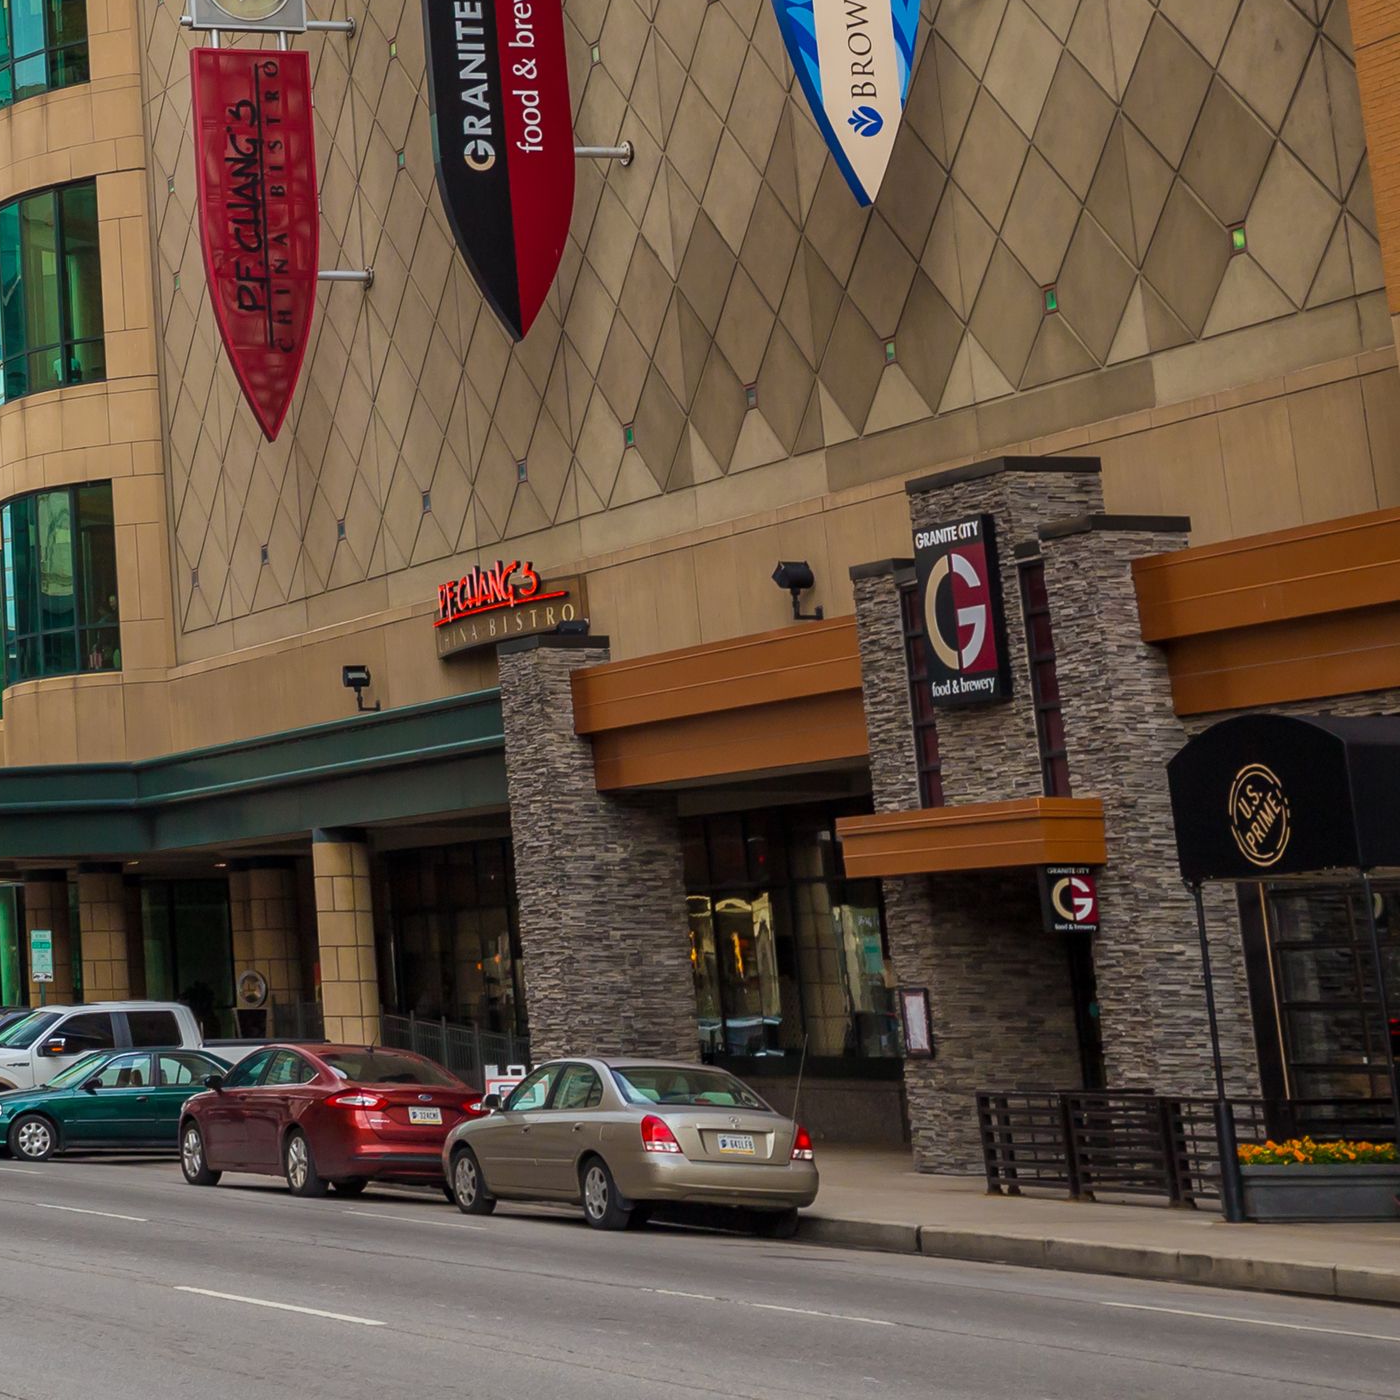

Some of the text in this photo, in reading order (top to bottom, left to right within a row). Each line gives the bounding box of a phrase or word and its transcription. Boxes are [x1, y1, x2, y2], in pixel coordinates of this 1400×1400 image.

[454, 1, 496, 171] GRANITE
[512, 58, 538, 79] &
[512, 90, 543, 153] food
[263, 61, 295, 353] CHINA BISTRO
[915, 520, 978, 549] GRANITE CITY
[490, 604, 575, 636] BISTRO
[925, 553, 986, 670] G
[932, 677, 995, 697] food & brewery
[1239, 785, 1262, 819] U.S.
[1246, 792, 1281, 853] PRIME
[1052, 877, 1093, 921] G
